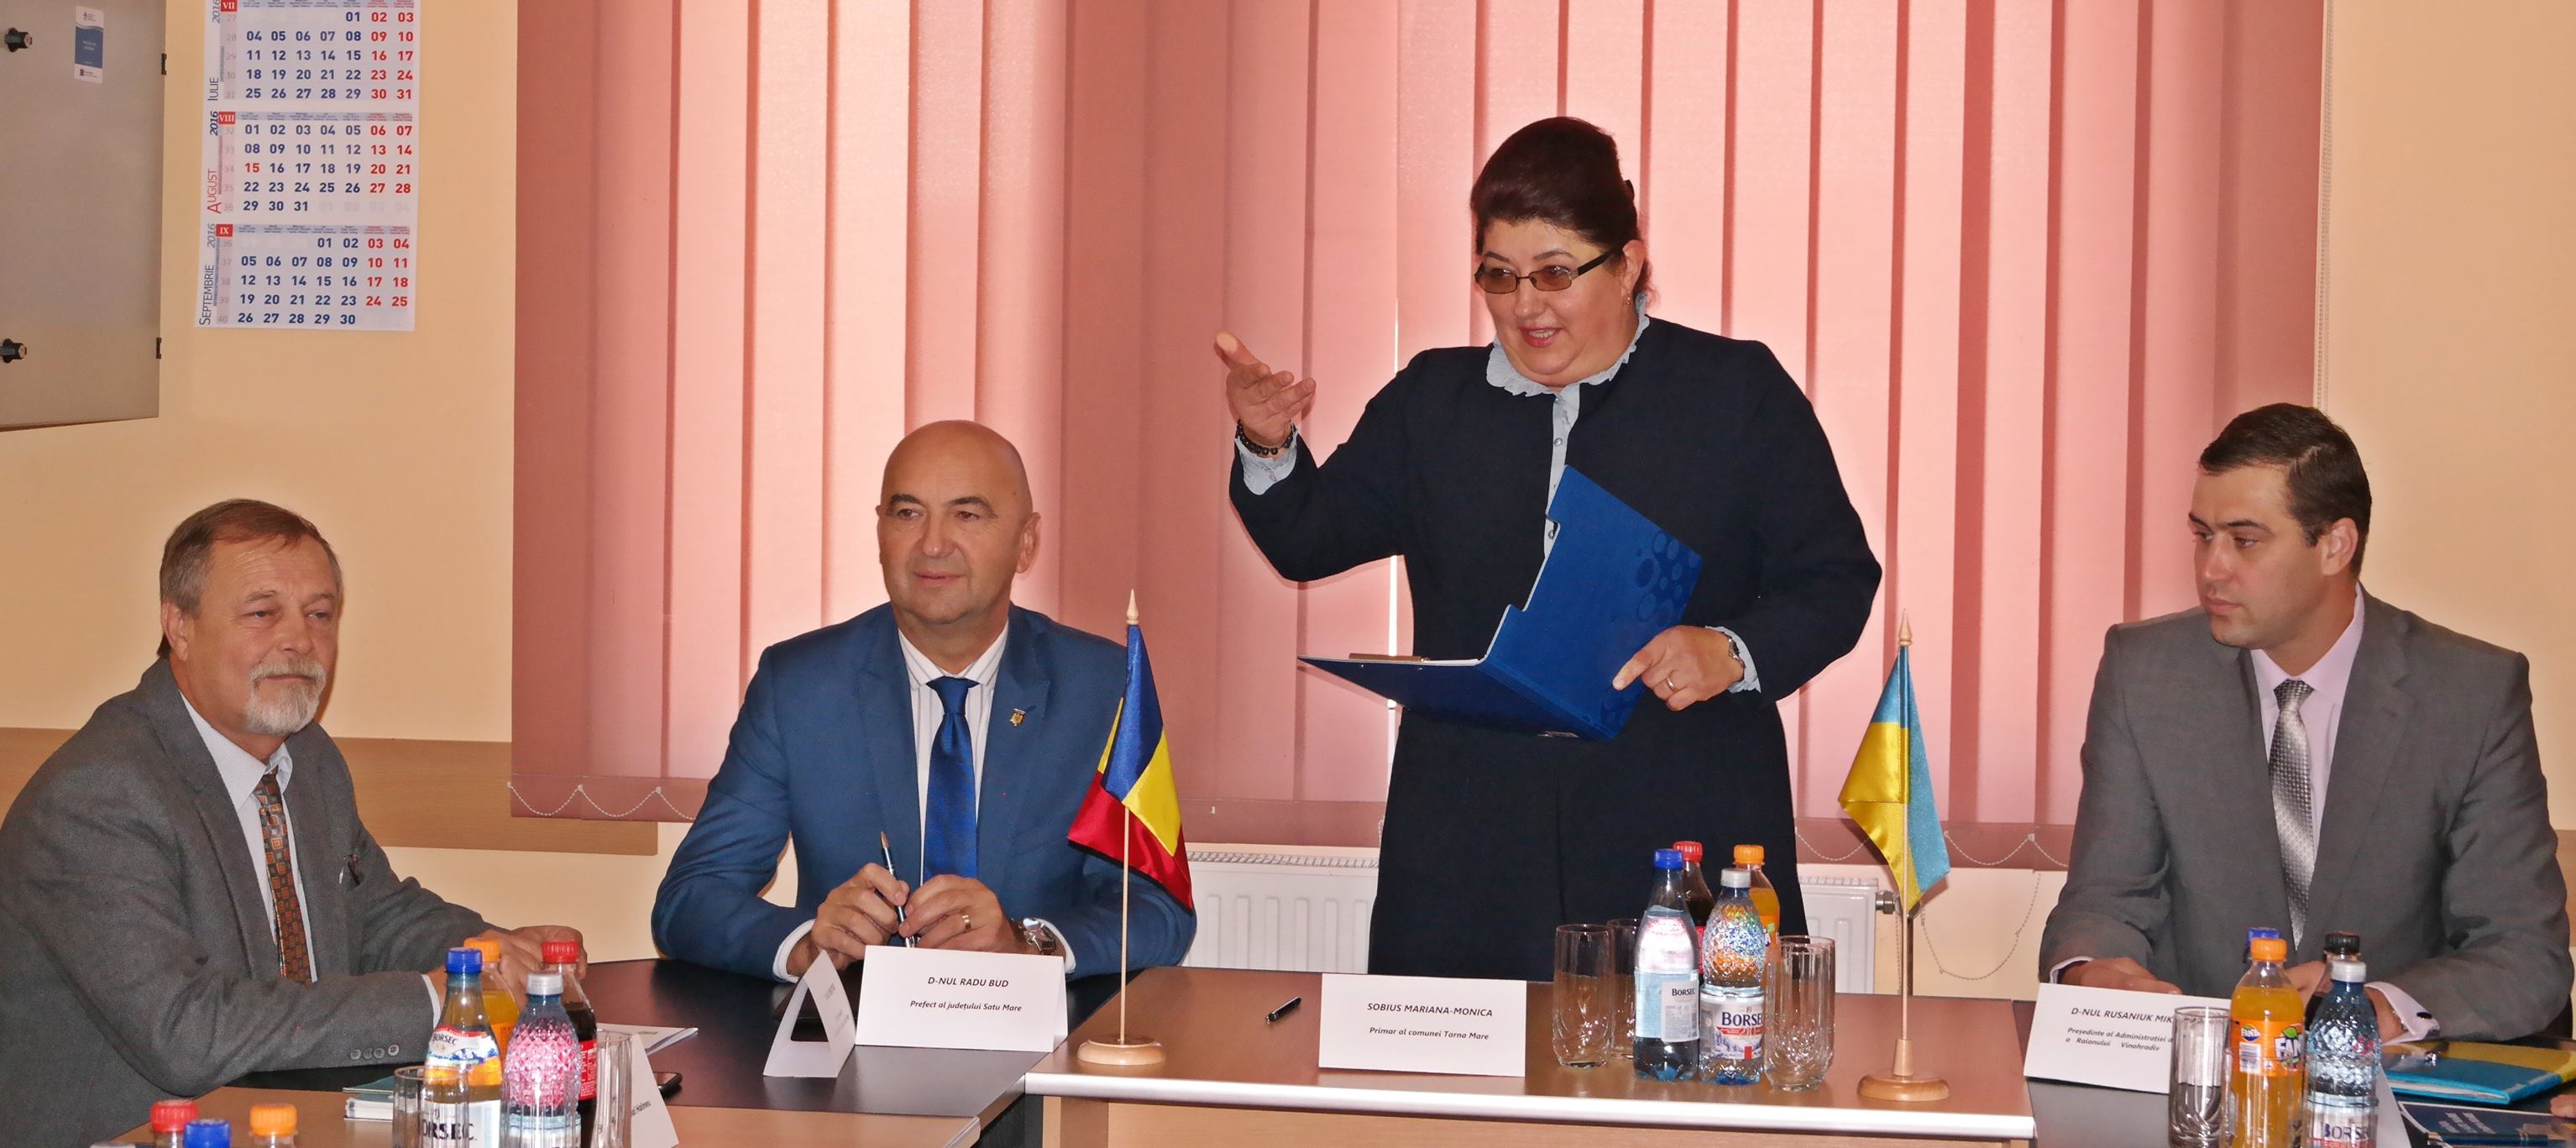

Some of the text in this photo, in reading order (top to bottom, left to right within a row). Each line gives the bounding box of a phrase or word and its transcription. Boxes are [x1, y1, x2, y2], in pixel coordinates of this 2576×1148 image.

[346, 12, 359, 22] 01
[372, 12, 387, 22] 02
[398, 13, 413, 23] 03
[247, 31, 262, 40] 04
[271, 31, 285, 41] 05
[296, 31, 311, 41] 06
[321, 31, 335, 41] 07
[346, 31, 361, 41] 08
[371, 31, 387, 41] 09
[398, 31, 413, 41] 10
[247, 50, 260, 60] 11
[272, 50, 285, 60] 12
[296, 50, 311, 60] 13
[322, 50, 335, 60] 14
[347, 50, 361, 60] 15
[372, 50, 386, 60] 16
[398, 51, 413, 60] 17
[247, 69, 261, 79] 18
[272, 70, 285, 80] 19
[296, 70, 311, 80] 20
[321, 70, 334, 79] 21
[346, 70, 361, 80] 22
[371, 70, 386, 80] 23
[397, 70, 413, 80] 24
[246, 88, 260, 98] 25
[271, 88, 286, 98] 26
[296, 88, 312, 98] 27
[321, 88, 336, 98] 28
[346, 89, 361, 98] 29
[371, 89, 386, 99] 30
[397, 89, 411, 99] 31
[210, 111, 218, 136] 2016
[245, 124, 259, 134] 01
[270, 125, 285, 134] 02
[296, 125, 311, 134] 03
[321, 125, 335, 134] 04
[346, 125, 360, 135] 05
[371, 125, 386, 135] 06
[397, 126, 412, 135] 07
[245, 144, 259, 154] 08
[270, 144, 285, 154] 09
[296, 144, 311, 154] 10
[321, 144, 333, 155] 11
[347, 144, 360, 155] 12
[371, 144, 386, 155] 13
[397, 145, 412, 155] 14
[245, 163, 259, 173] 15
[270, 163, 285, 173] 16
[296, 163, 311, 173] 17
[321, 164, 335, 174] 18
[347, 164, 360, 174] 19
[370, 164, 385, 174] 20
[396, 165, 410, 174] 21
[207, 169, 222, 214] AUGUST
[244, 181, 259, 191] 22
[269, 182, 284, 192] 23
[295, 182, 310, 192] 24
[319, 182, 334, 192] 25
[345, 183, 360, 193] 26
[370, 183, 385, 193] 27
[395, 183, 411, 193] 28
[243, 201, 259, 211] 29
[269, 201, 284, 211] 30
[294, 202, 307, 211] 31
[317, 238, 331, 248] 01
[343, 238, 359, 248] 02
[369, 239, 383, 249] 03
[394, 239, 409, 249] 04
[242, 256, 256, 266] 05
[266, 256, 281, 266] 06
[292, 257, 307, 266] 07
[317, 257, 332, 267] 08
[343, 257, 358, 267] 09
[369, 258, 382, 268] 10
[394, 258, 407, 268] 11
[242, 275, 255, 285] 12
[266, 275, 280, 286] 13
[292, 275, 306, 286] 14
[317, 276, 331, 286] 15
[343, 276, 357, 286] 16
[368, 277, 382, 286] 17
[393, 277, 408, 287] 18
[199, 265, 214, 325] SEPTEMBRIE
[240, 294, 254, 304] 19
[264, 295, 280, 304] 20
[291, 295, 304, 305] 21
[316, 295, 330, 305] 22
[341, 296, 356, 306] 23
[366, 296, 381, 306] 24
[392, 296, 407, 307] 25
[238, 312, 253, 322] 26
[264, 313, 279, 322] 27
[289, 313, 304, 323] 28
[314, 314, 330, 324] 29
[340, 314, 355, 324] 30
[927, 977, 1009, 988] D-NUL RADU BUD
[910, 1000, 937, 1009] Prefect
[1367, 1003, 1493, 1017] SOBIUS MARIANA-MONICA
[2071, 1007, 2173, 1024] D-NUL RUSANIUK MIK
[1443, 1030, 1467, 1039] Tarna
[1469, 1032, 1490, 1041] Mare
[2076, 1037, 2112, 1047] Raionului
[2275, 1035, 2302, 1061] FAN
[422, 1119, 474, 1140] ORSEC
